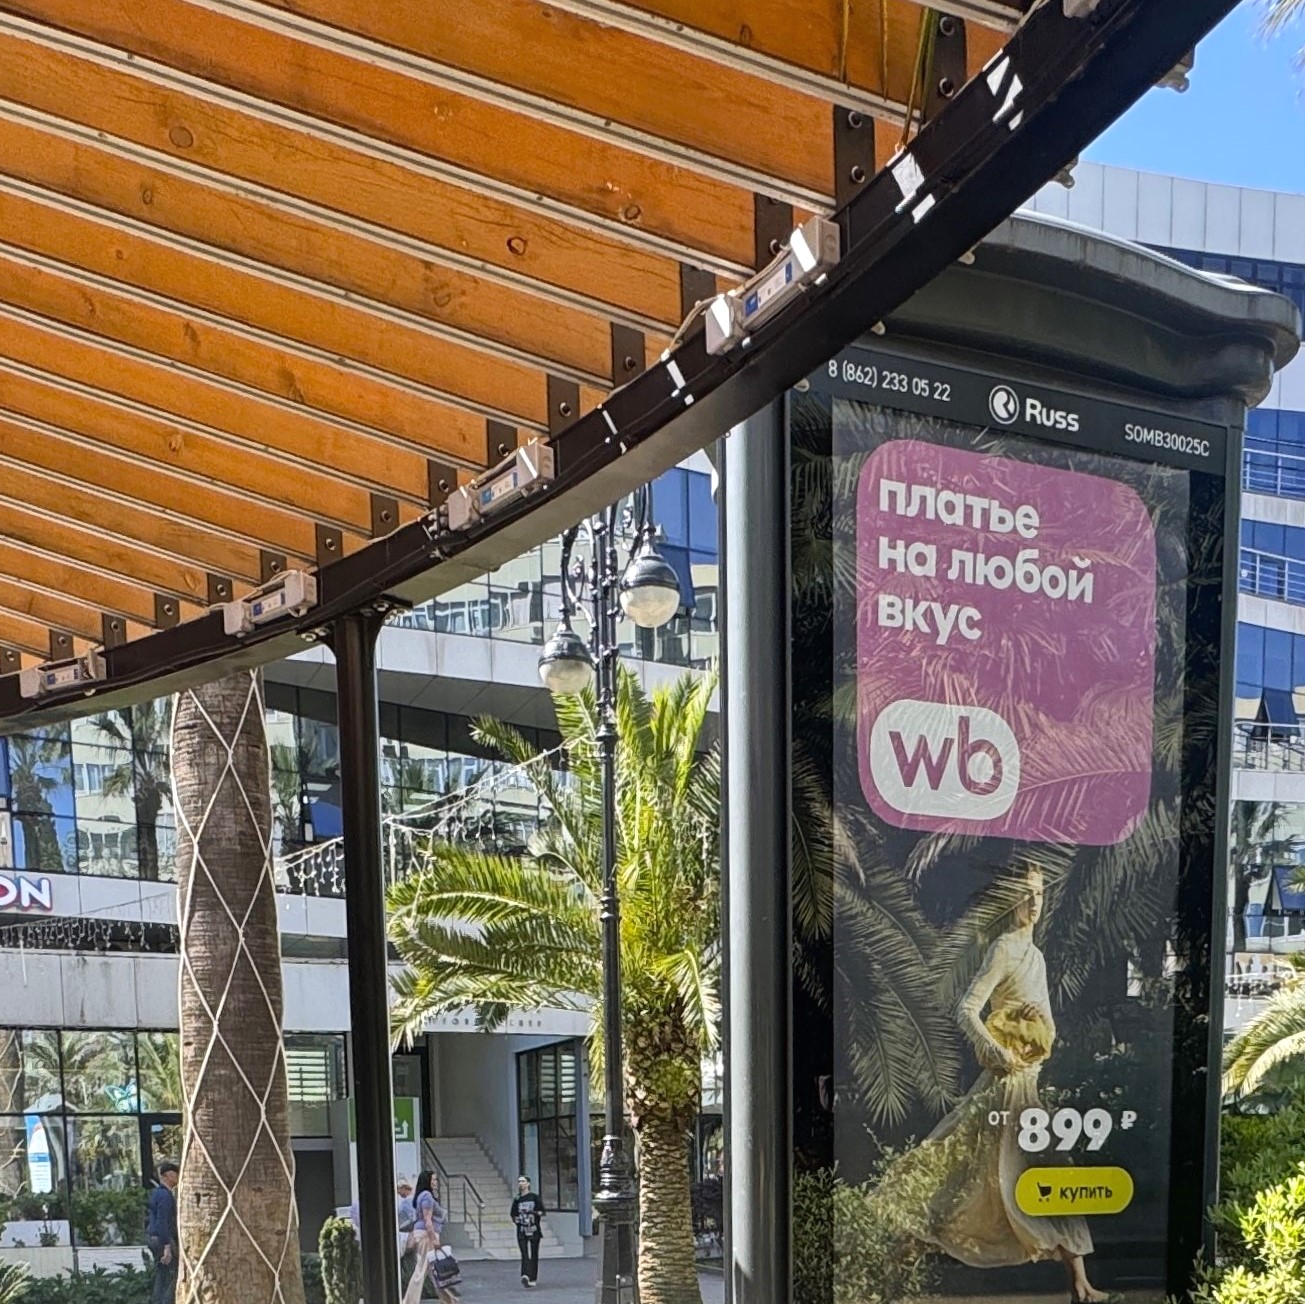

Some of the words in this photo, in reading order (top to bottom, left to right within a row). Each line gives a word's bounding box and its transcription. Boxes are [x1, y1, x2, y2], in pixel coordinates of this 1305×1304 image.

[828, 359, 839, 378] 8
[842, 359, 878, 389] (862)
[881, 370, 908, 392] 233
[912, 377, 930, 397] 05
[933, 381, 951, 402] 22
[1024, 397, 1080, 432] Russ
[878, 477, 1040, 539] платье
[877, 535, 938, 578] на
[947, 547, 1095, 604] любой
[877, 593, 983, 646] вкус
[888, 715, 1004, 796] wb
[1017, 1107, 1113, 1152] 899
[1059, 1185, 1113, 1203] купить
